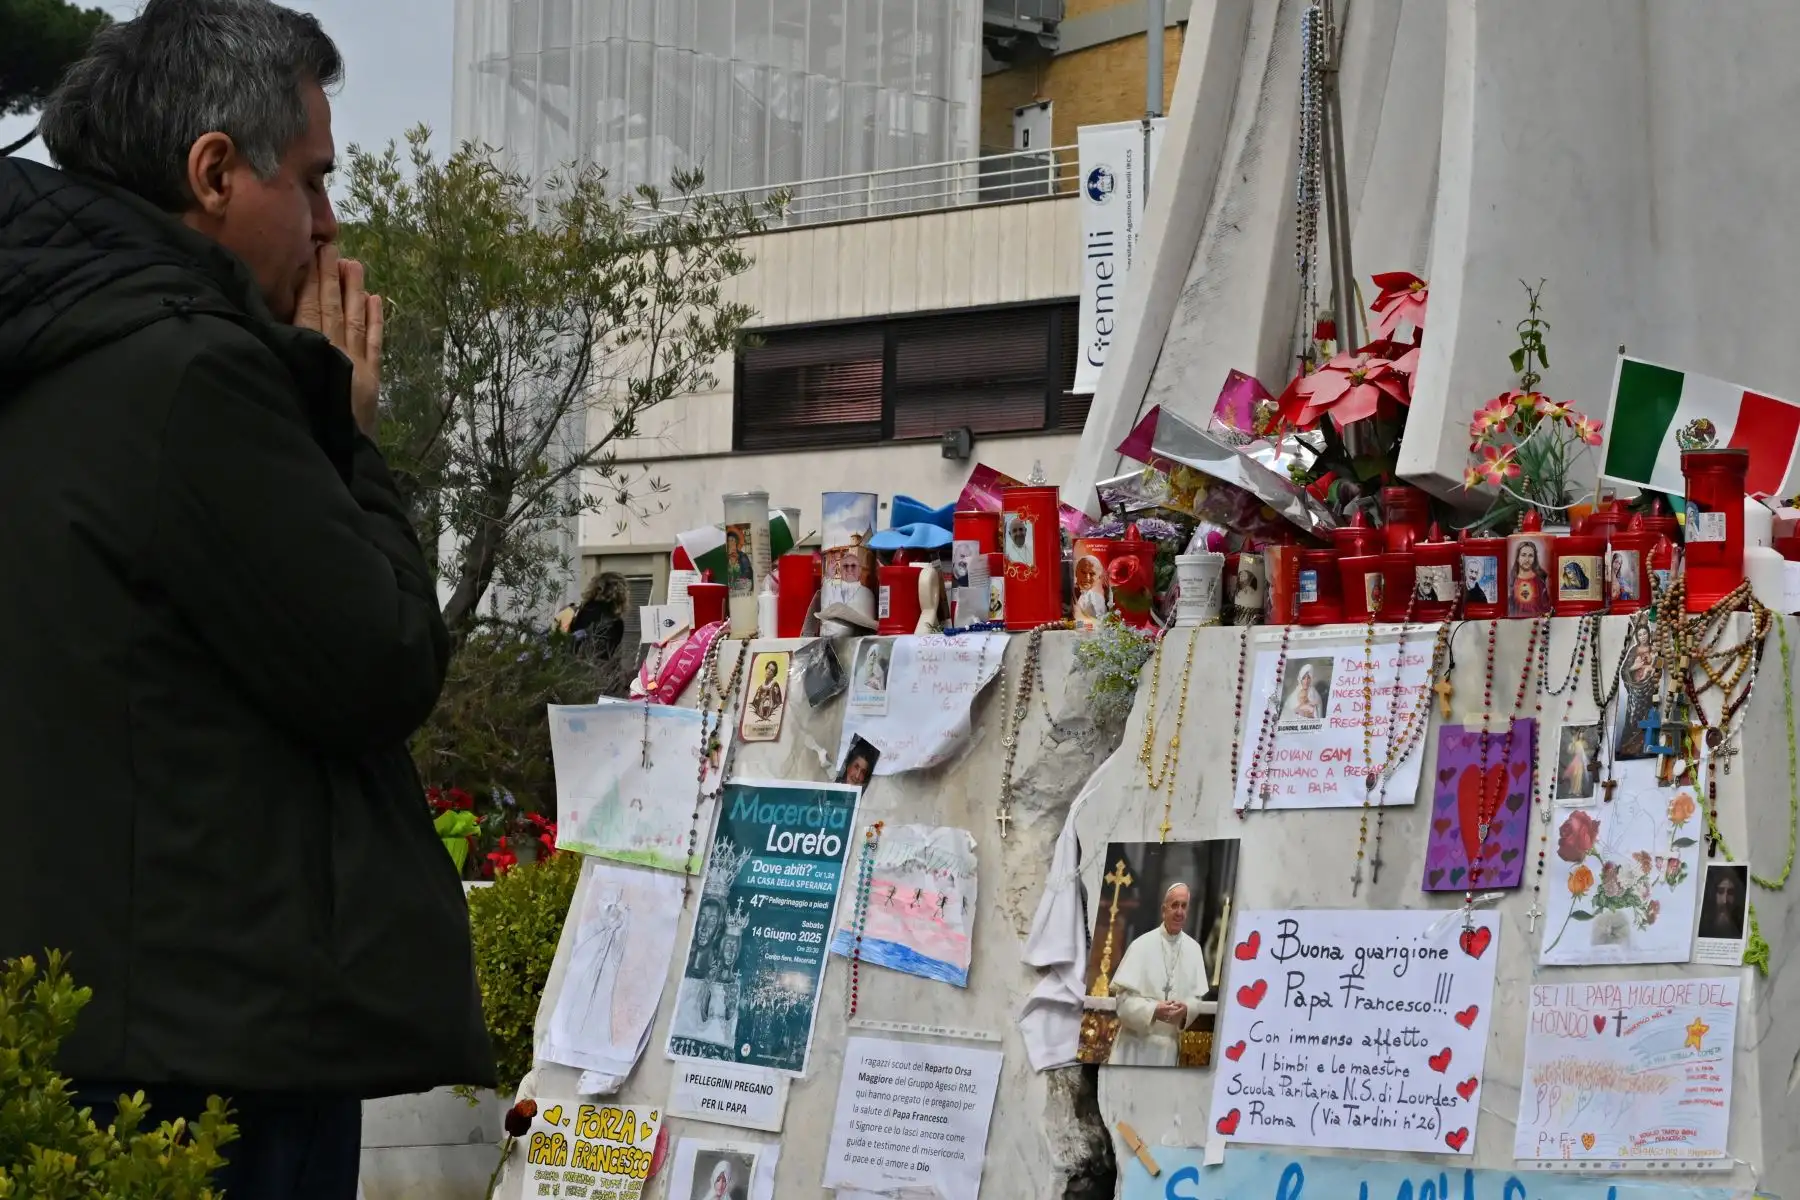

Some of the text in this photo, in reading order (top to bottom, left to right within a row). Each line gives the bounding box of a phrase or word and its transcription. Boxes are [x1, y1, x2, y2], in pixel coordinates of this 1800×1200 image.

[1087, 231, 1114, 367] Gemelli
[1320, 748, 1351, 762] GAM
[1326, 768, 1334, 777] A
[1287, 784, 1296, 794] IL
[1308, 783, 1337, 793] PAPA
[730, 790, 848, 829] Macerata
[766, 824, 842, 857] Loreto
[747, 877, 832, 892] LA CASA DELLA SPERANZA
[769, 896, 808, 909] Pellegrinaggio
[814, 901, 828, 910] piedi
[752, 927, 821, 944] 14 Giugno 2025
[802, 920, 824, 930] Sabato
[1270, 918, 1449, 978] Buona guarigione
[1284, 970, 1333, 1021] Papa
[1533, 982, 1726, 1007] SEI IL PAPA MIGLIORE DEL
[1532, 1010, 1588, 1035] MONDO
[1249, 1020, 1428, 1056] Con immenso affetto
[865, 1058, 890, 1069] ragazzi
[891, 1061, 911, 1070] scout
[912, 1062, 924, 1072] del
[925, 1063, 953, 1075] Reparto
[955, 1066, 972, 1077] Orsa
[1261, 1053, 1410, 1078] I bimbi e le maestre
[685, 1073, 774, 1095] I PELLEGRINI PREGANO
[858, 1072, 893, 1086] Maggiore
[895, 1076, 906, 1086] del
[907, 1077, 934, 1090] Gruppo
[935, 1081, 958, 1092] Agesci
[1227, 1073, 1275, 1097] Scuola
[1279, 1074, 1339, 1100] Paritaria
[1378, 1086, 1392, 1101] di
[1396, 1080, 1458, 1108] Lourdes
[701, 1098, 747, 1114] PER IL PAPA
[853, 1104, 860, 1113] la
[861, 1105, 882, 1116] salute
[884, 1107, 891, 1117] di
[892, 1109, 910, 1120] Papa
[856, 1090, 867, 1100] qui
[868, 1090, 891, 1101] hanno
[892, 1094, 921, 1105] pregato
[931, 1098, 962, 1111] pregano)
[963, 1102, 976, 1111] per
[575, 1105, 636, 1145] FORZA
[1249, 1100, 1296, 1128] Roma
[1310, 1102, 1340, 1136] (Via
[1343, 1103, 1397, 1128] Tardini
[850, 1120, 854, 1129] Il
[855, 1121, 883, 1133] Signore
[893, 1126, 901, 1135] lo
[902, 1127, 918, 1137] lasci
[920, 1130, 944, 1141] ancora
[946, 1134, 965, 1143] come
[527, 1132, 653, 1179] PAPA FRANCESCO
[846, 1137, 866, 1148] guida
[873, 1139, 910, 1152] testimone
[912, 1143, 919, 1153] di
[920, 1146, 966, 1161] misericordia,
[844, 1153, 851, 1162] di
[852, 1155, 869, 1164] pace
[876, 1156, 884, 1165] di
[885, 1159, 908, 1169] amore
